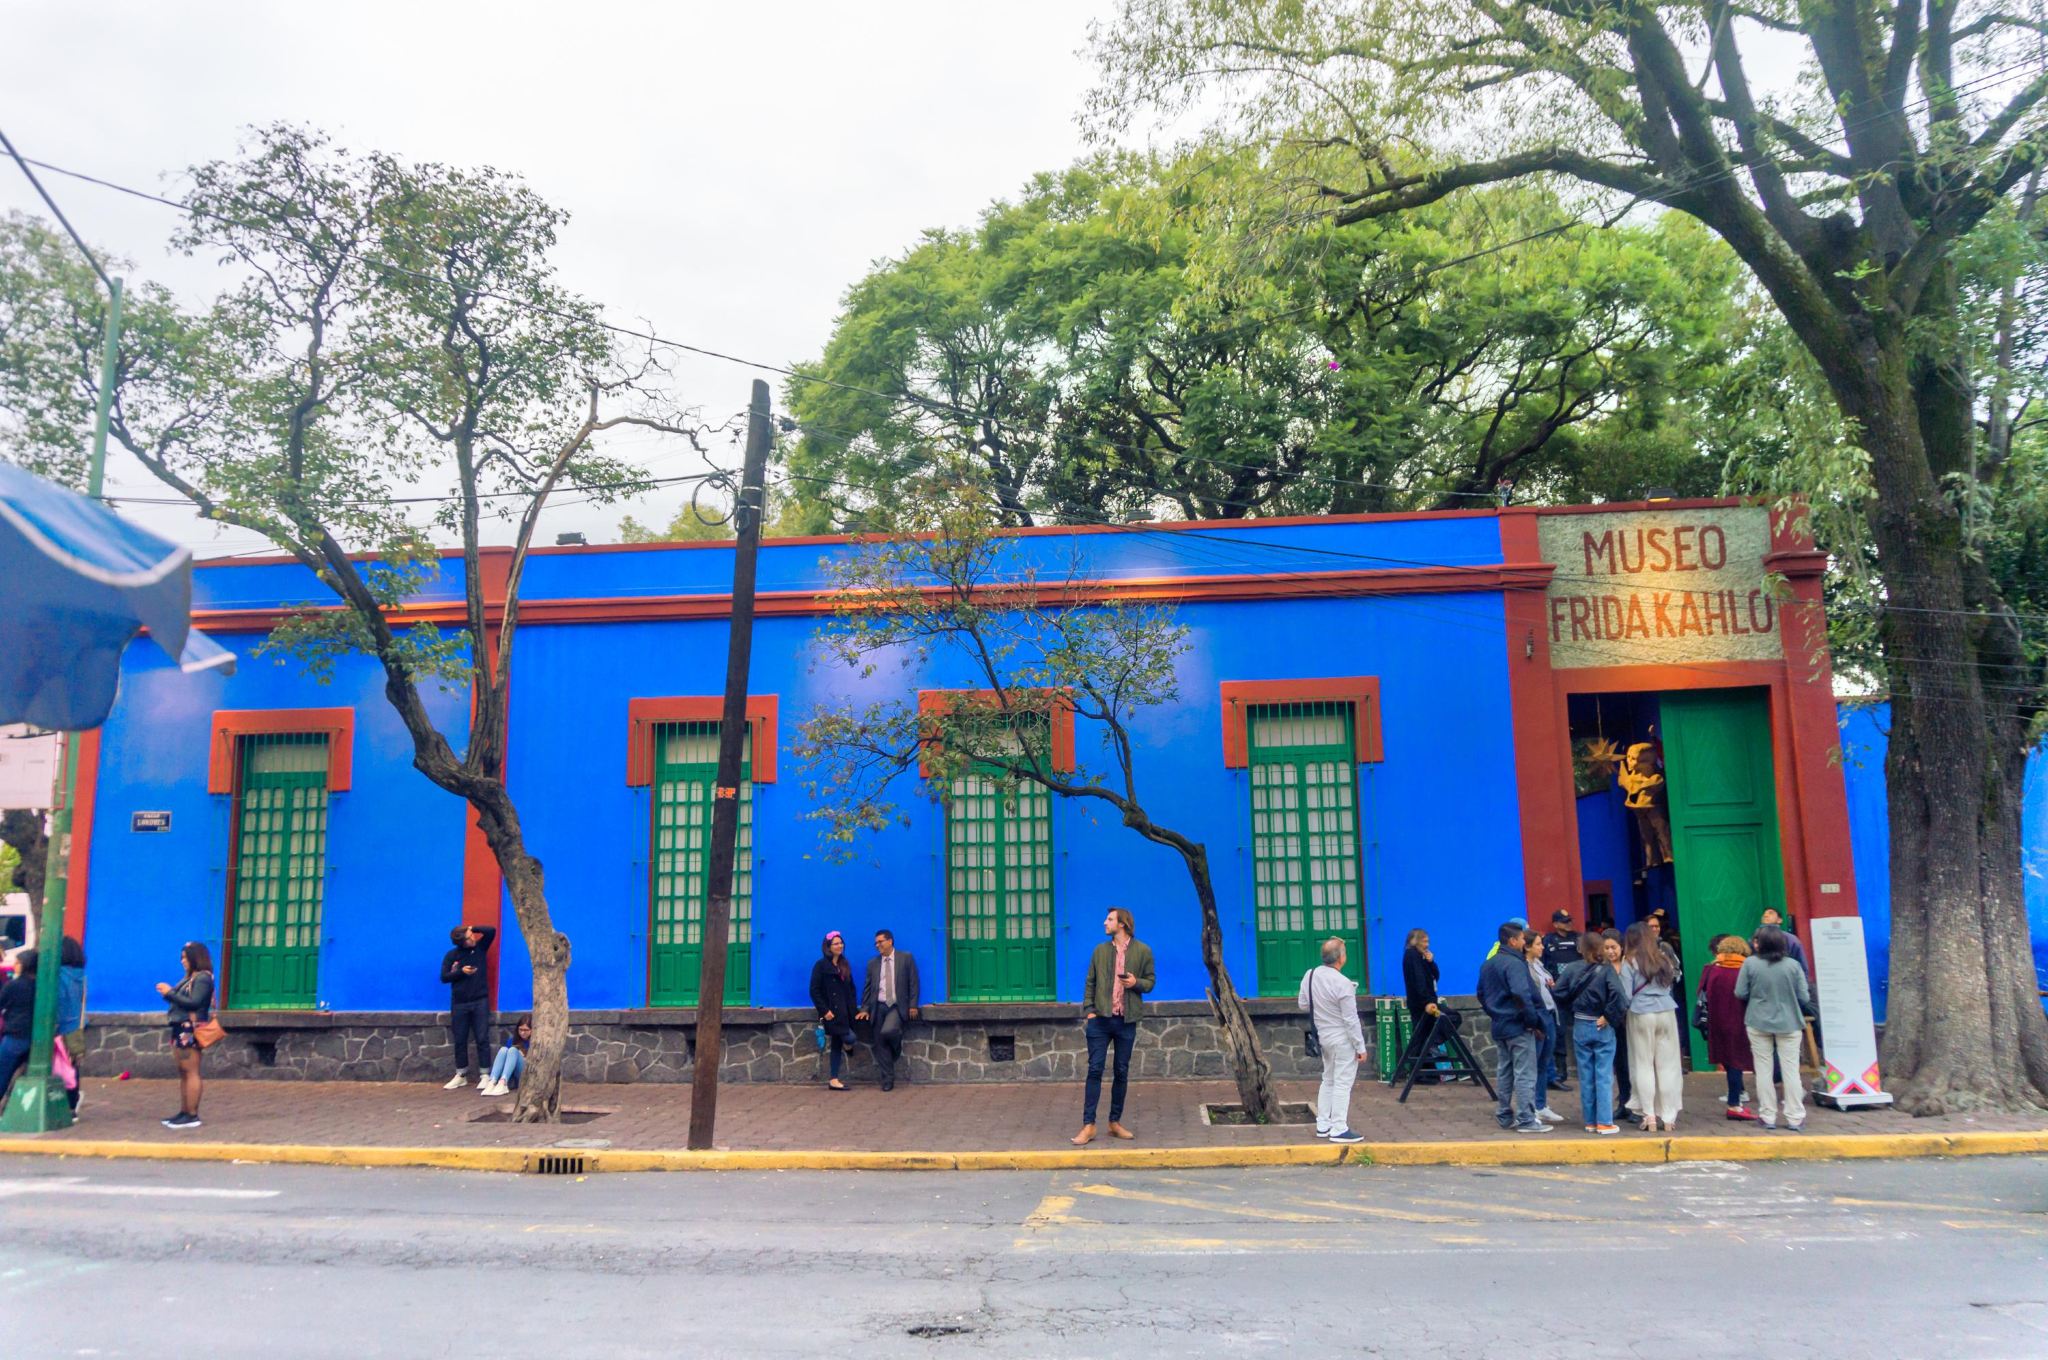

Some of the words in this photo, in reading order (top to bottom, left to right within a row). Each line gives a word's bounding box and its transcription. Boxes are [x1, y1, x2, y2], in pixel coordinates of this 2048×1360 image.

[1583, 525, 1727, 576] MUSEO
[1551, 593, 1649, 643] FRIDA
[1652, 588, 1773, 638] KAHLO
